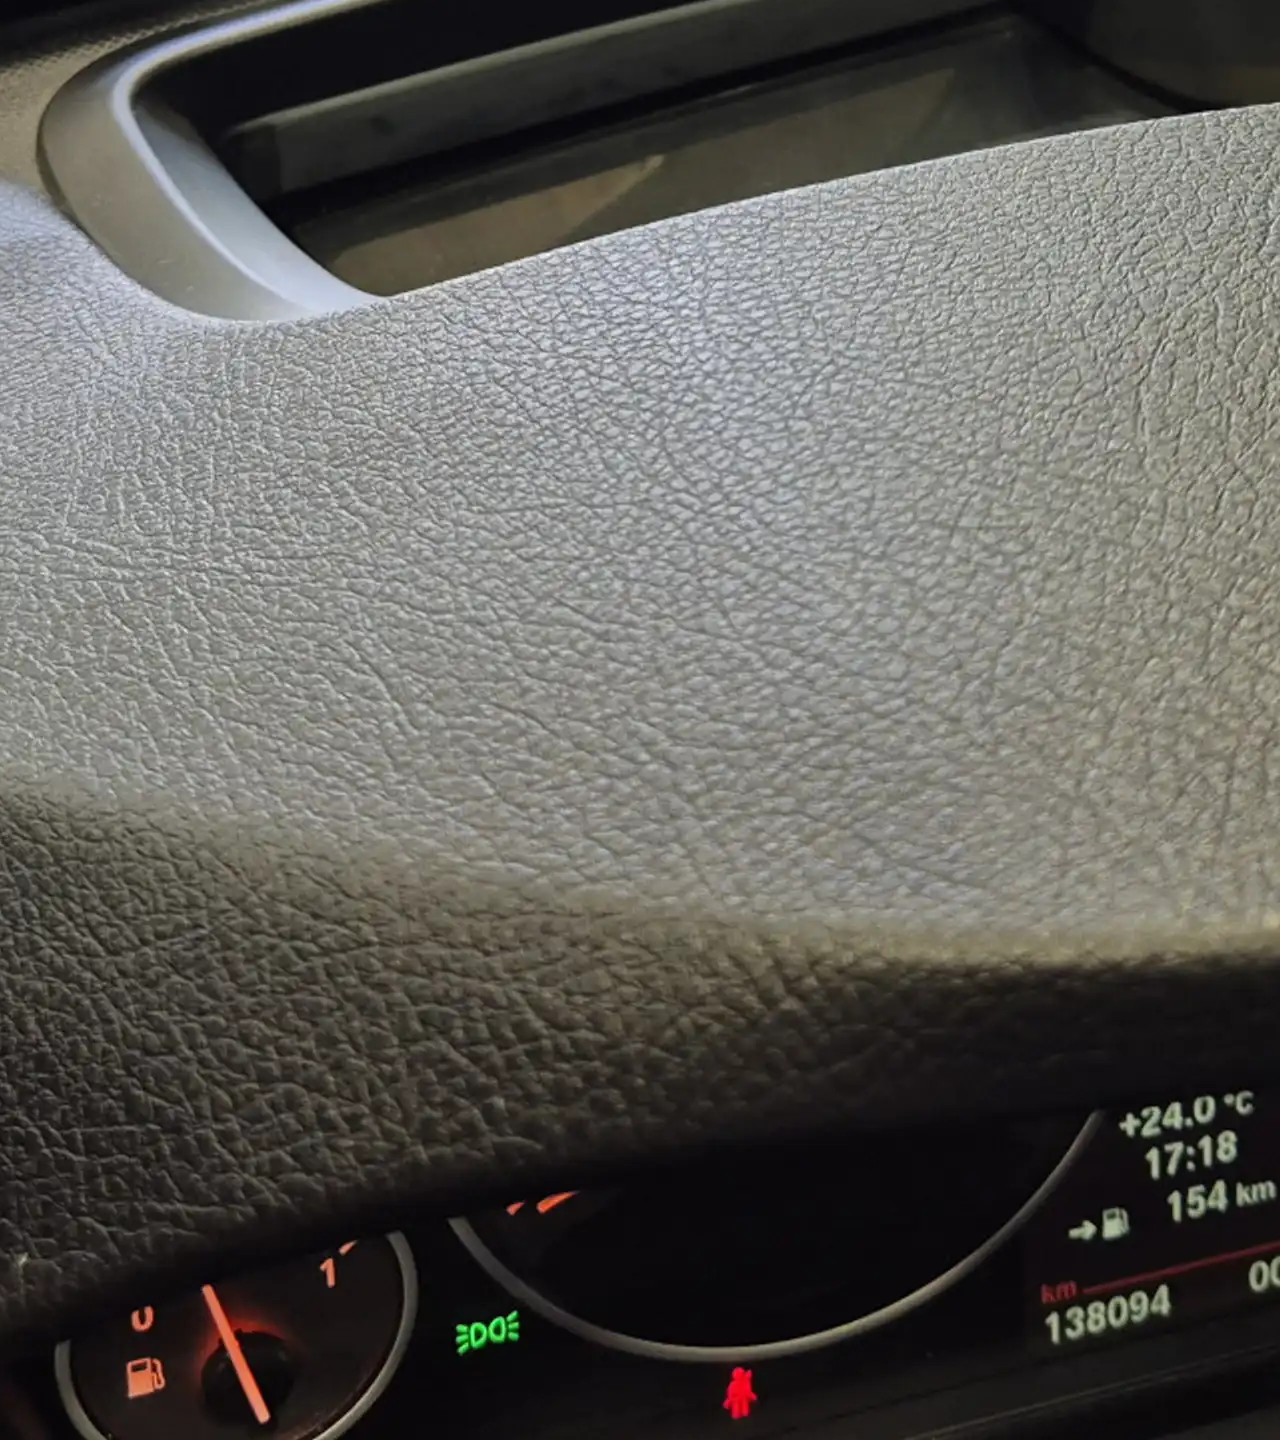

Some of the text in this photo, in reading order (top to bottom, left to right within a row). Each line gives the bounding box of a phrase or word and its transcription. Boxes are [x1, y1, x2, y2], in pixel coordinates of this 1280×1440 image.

[1119, 1095, 1217, 1138] +24.0
[1144, 1130, 1238, 1180] 17:18
[1167, 1179, 1277, 1222] 154 km
[1040, 1280, 1078, 1304] km
[1044, 1284, 1172, 1345] 138094
